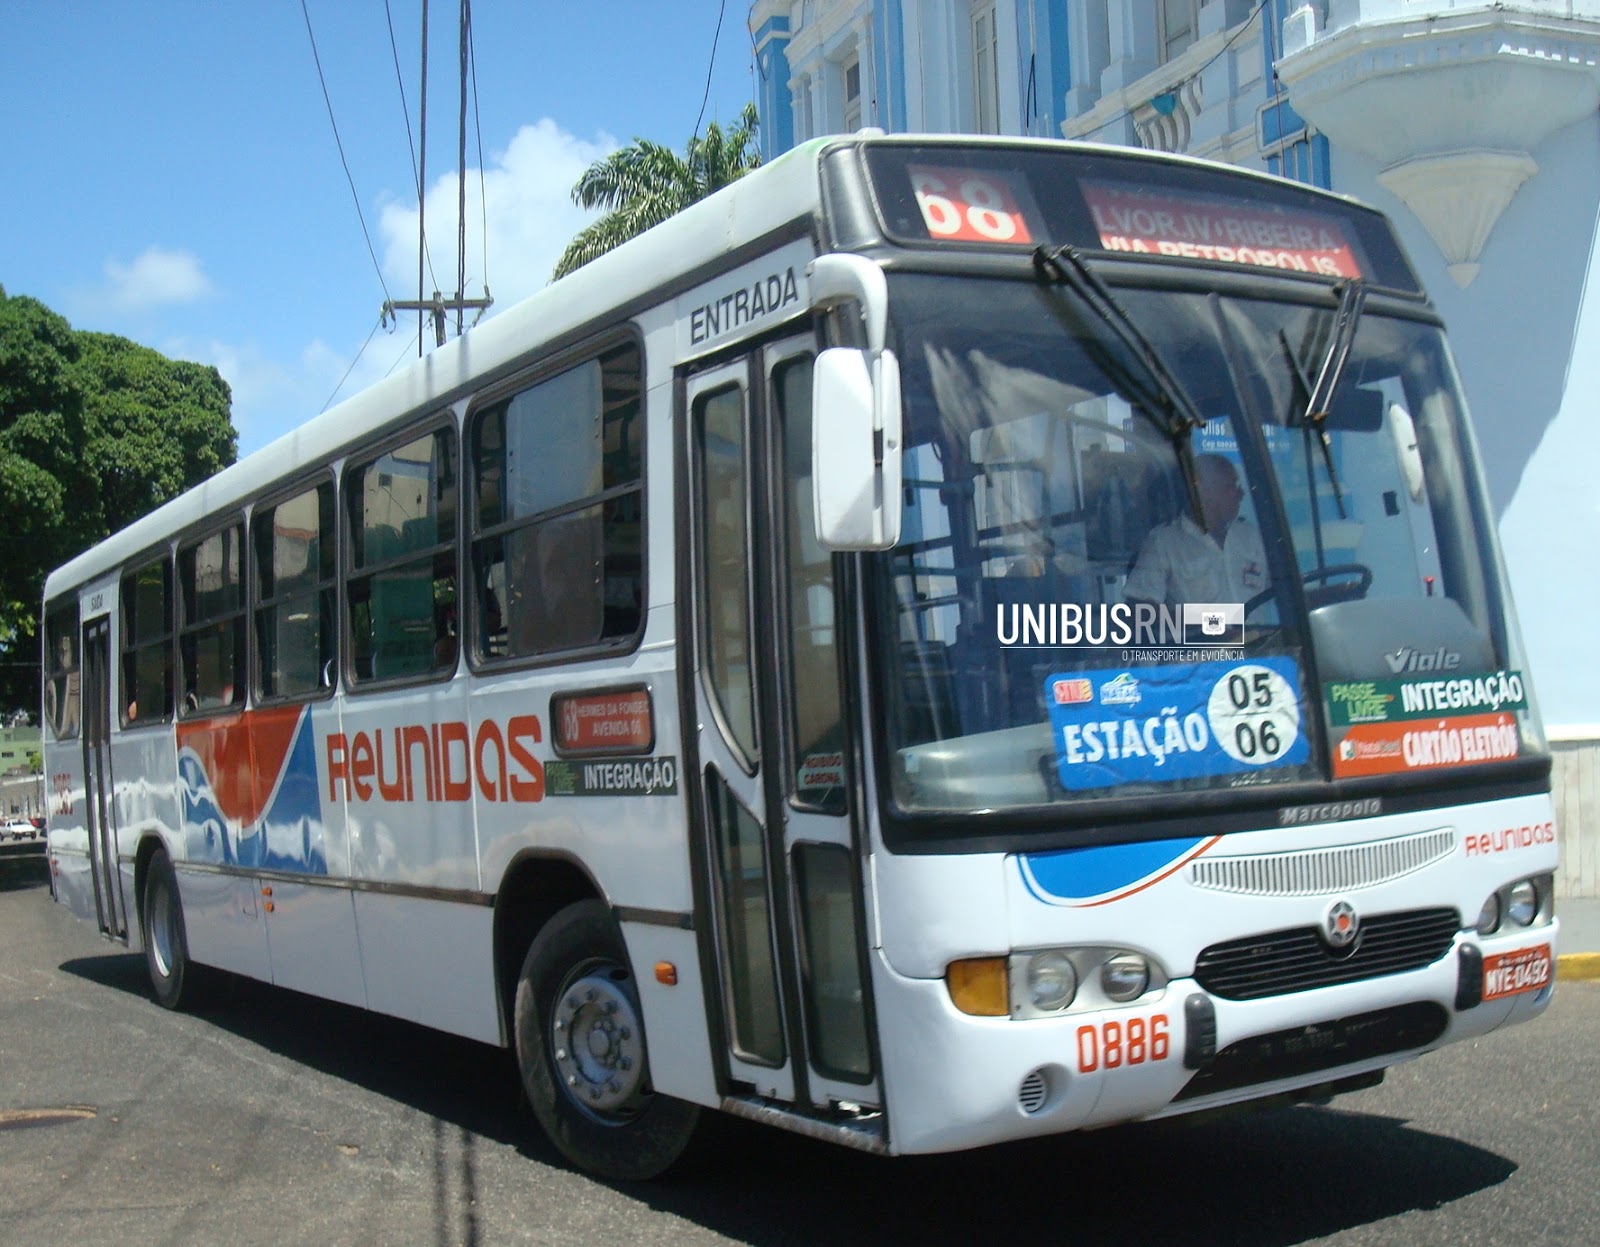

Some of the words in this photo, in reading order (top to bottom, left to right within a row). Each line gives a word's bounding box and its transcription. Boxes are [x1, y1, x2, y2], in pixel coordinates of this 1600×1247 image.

[910, 174, 1016, 240] 68
[691, 266, 799, 346] ENTRADA
[1384, 647, 1462, 674] Viale
[1228, 673, 1273, 709] 05
[1401, 671, 1524, 713] INTEGRAÇÃO
[592, 720, 629, 737] AVENIDA
[1063, 706, 1210, 767] ESTAÇÃO
[1235, 720, 1281, 758] 06
[584, 757, 674, 794] INTEGRAÇÃO
[1280, 800, 1382, 825] Marcopolo
[1077, 1014, 1171, 1074] 0886
